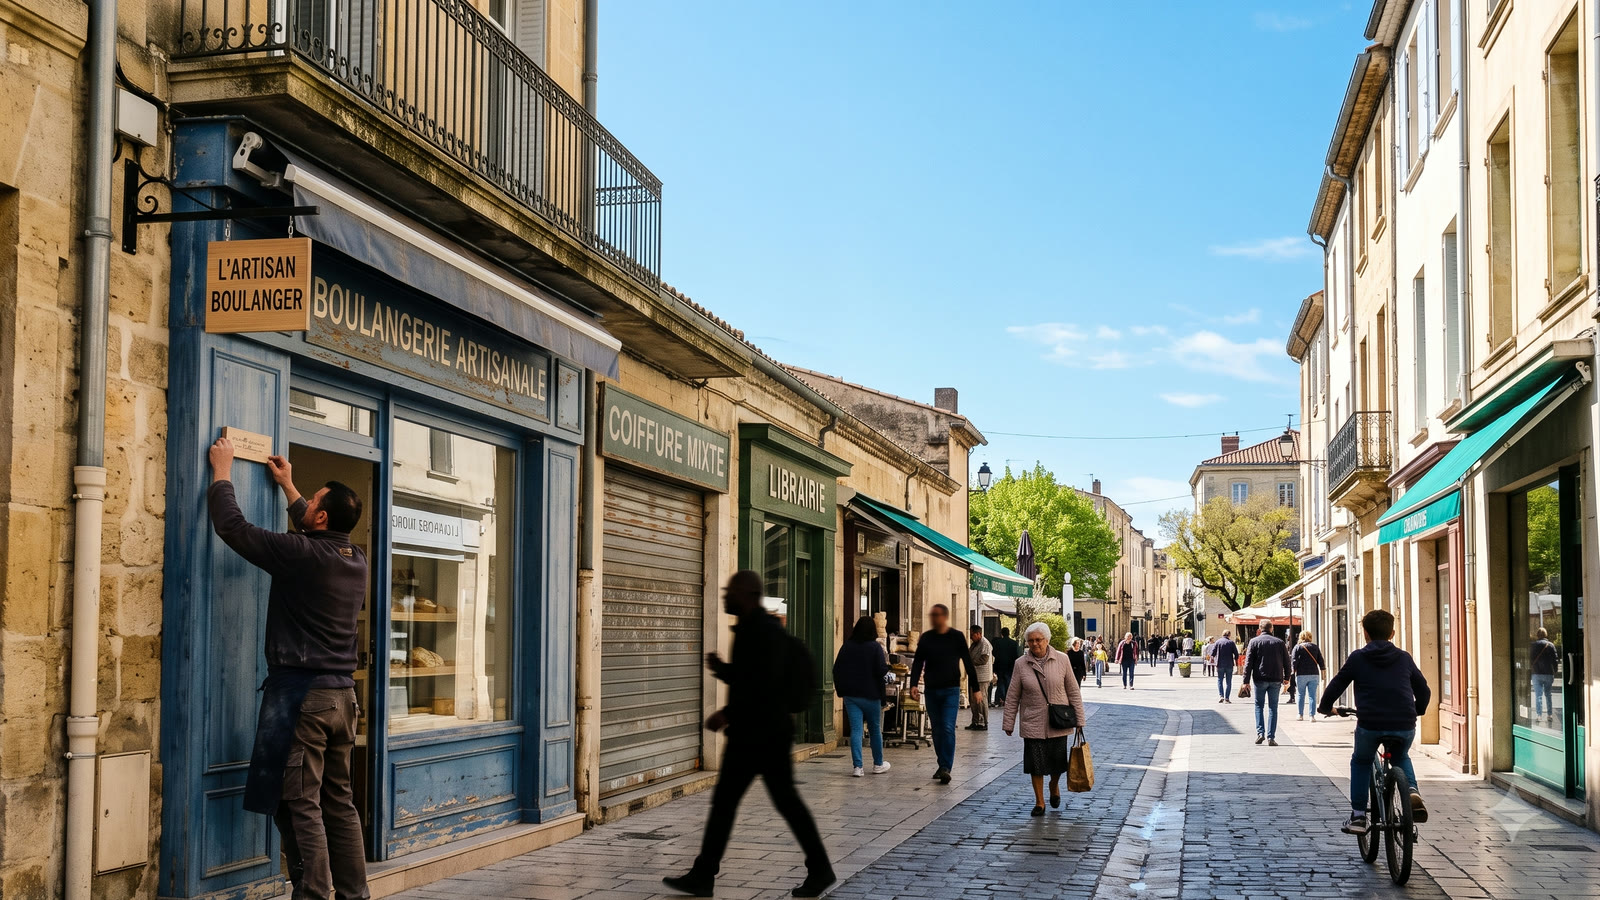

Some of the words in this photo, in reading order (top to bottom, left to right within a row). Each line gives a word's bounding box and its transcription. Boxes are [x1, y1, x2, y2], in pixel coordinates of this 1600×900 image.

[218, 255, 296, 281] L'ARTISAN
[211, 288, 303, 313] BOULANGER
[313, 275, 452, 367] BOULANGERIE
[455, 336, 546, 402] ARTISANALE
[608, 404, 683, 464] COIFFURE
[687, 434, 725, 478] MIXTE
[768, 463, 826, 514] LIBRAIRIE
